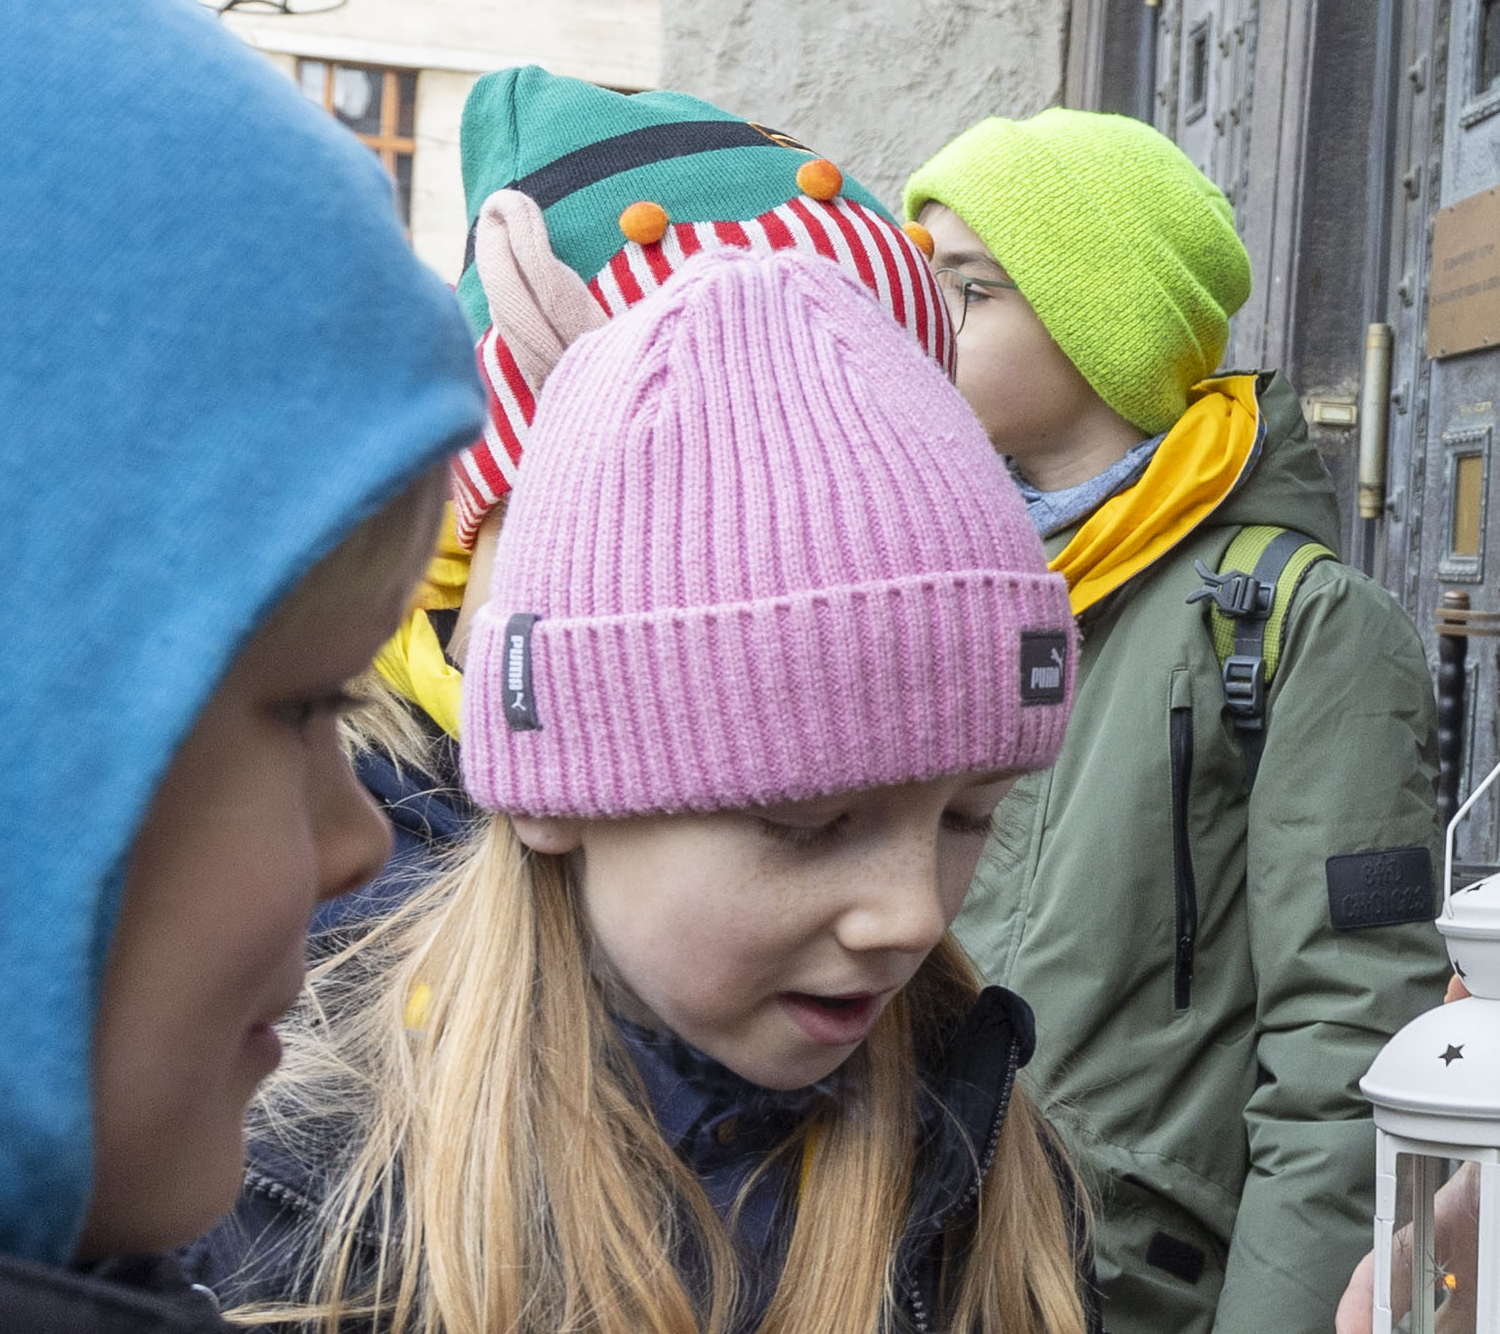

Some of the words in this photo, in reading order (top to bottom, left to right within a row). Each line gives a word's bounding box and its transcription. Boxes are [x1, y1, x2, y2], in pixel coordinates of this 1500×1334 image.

[508, 634, 525, 691] PUMA
[1030, 666, 1060, 689] PUMA
[1361, 858, 1403, 887] BAD
